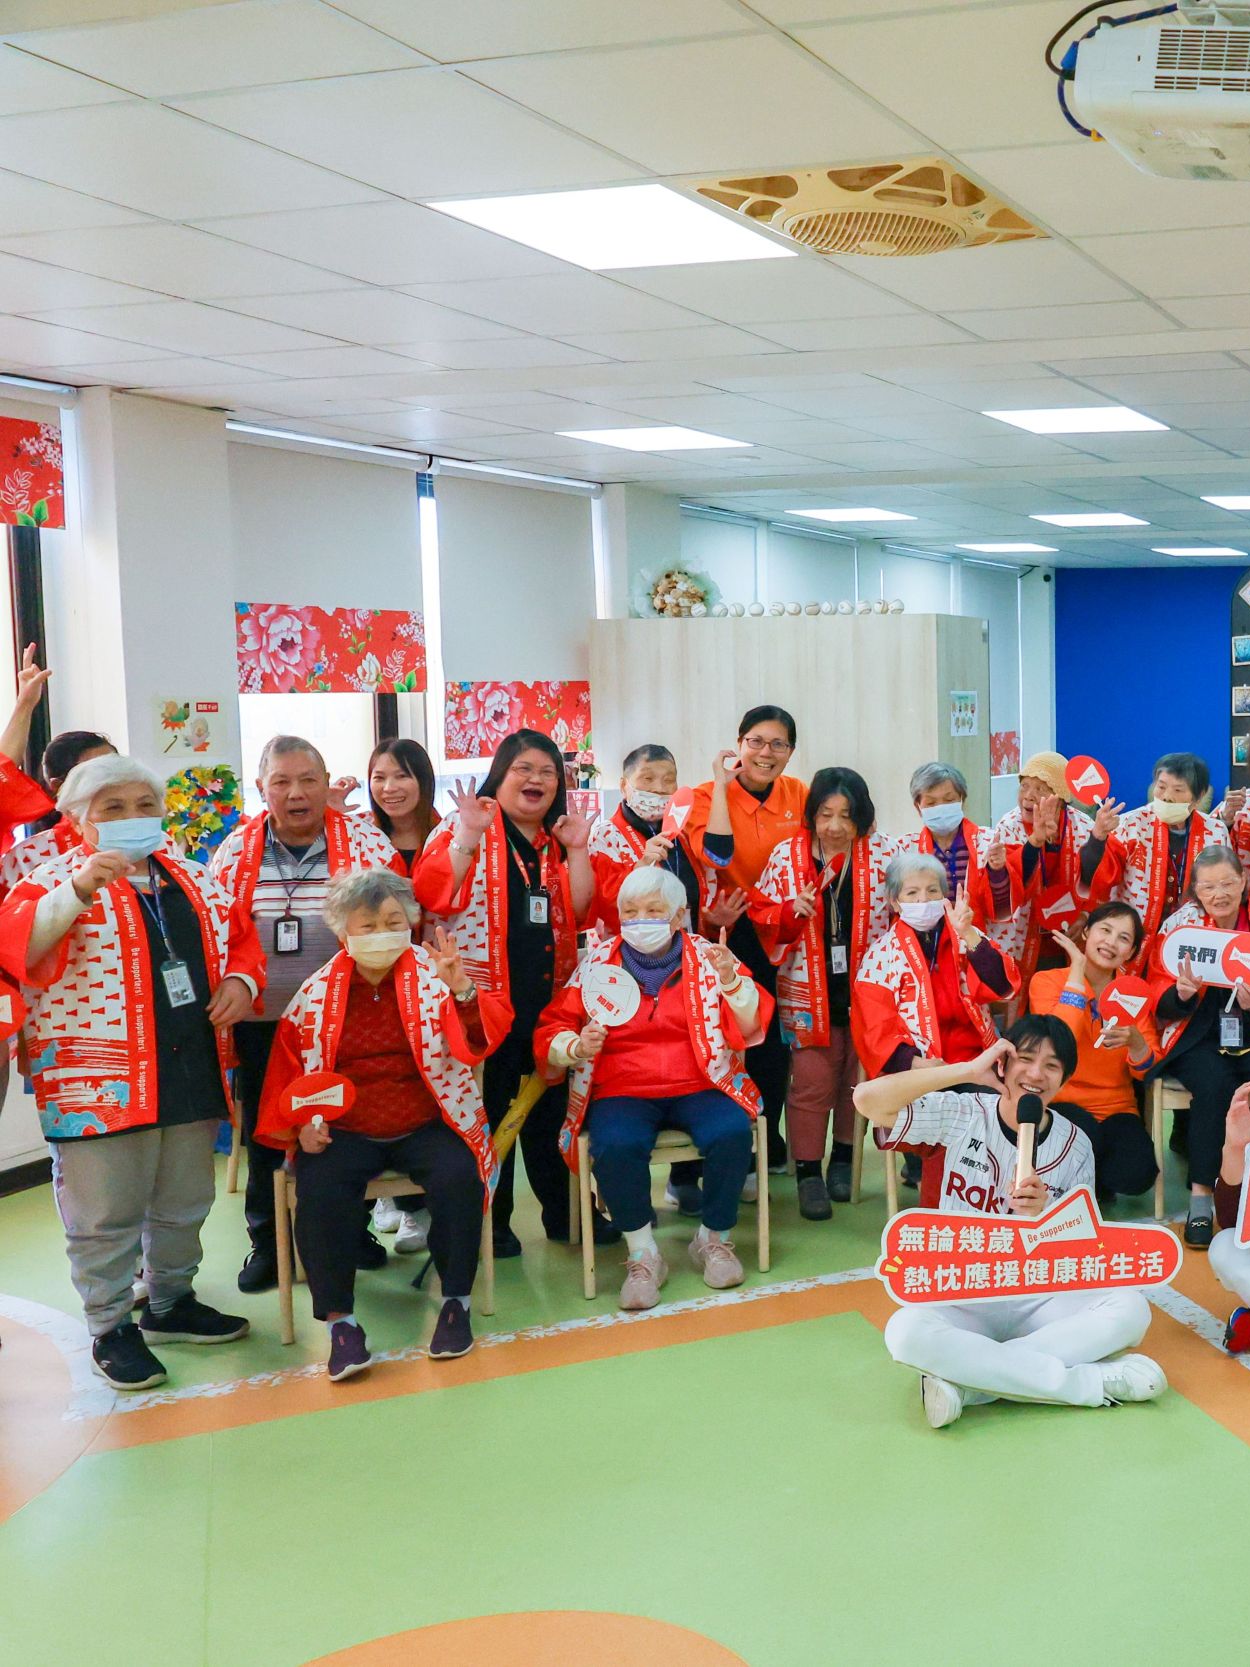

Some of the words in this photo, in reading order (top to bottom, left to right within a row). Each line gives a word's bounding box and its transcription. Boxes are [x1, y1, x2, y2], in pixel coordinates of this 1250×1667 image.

[124, 904, 139, 940] supporters!
[493, 895, 501, 928] supporters!
[131, 948, 140, 957] Be
[1178, 945, 1217, 964] 我們
[132, 957, 145, 996] supporters!
[336, 972, 344, 981] Be
[403, 972, 411, 980] Be
[135, 1004, 144, 1013] Be
[330, 982, 341, 1017] supporters!
[405, 981, 414, 1021] supporters!
[136, 1014, 147, 1053] supporters!
[139, 1060, 148, 1069] Be
[139, 1070, 148, 1110] supporters!
[897, 1224, 1015, 1253] 無論幾歲
[1027, 1232, 1038, 1244] Be
[1039, 1215, 1083, 1240] supporters!
[903, 1250, 1163, 1294] 熱忱應援健康新生活
